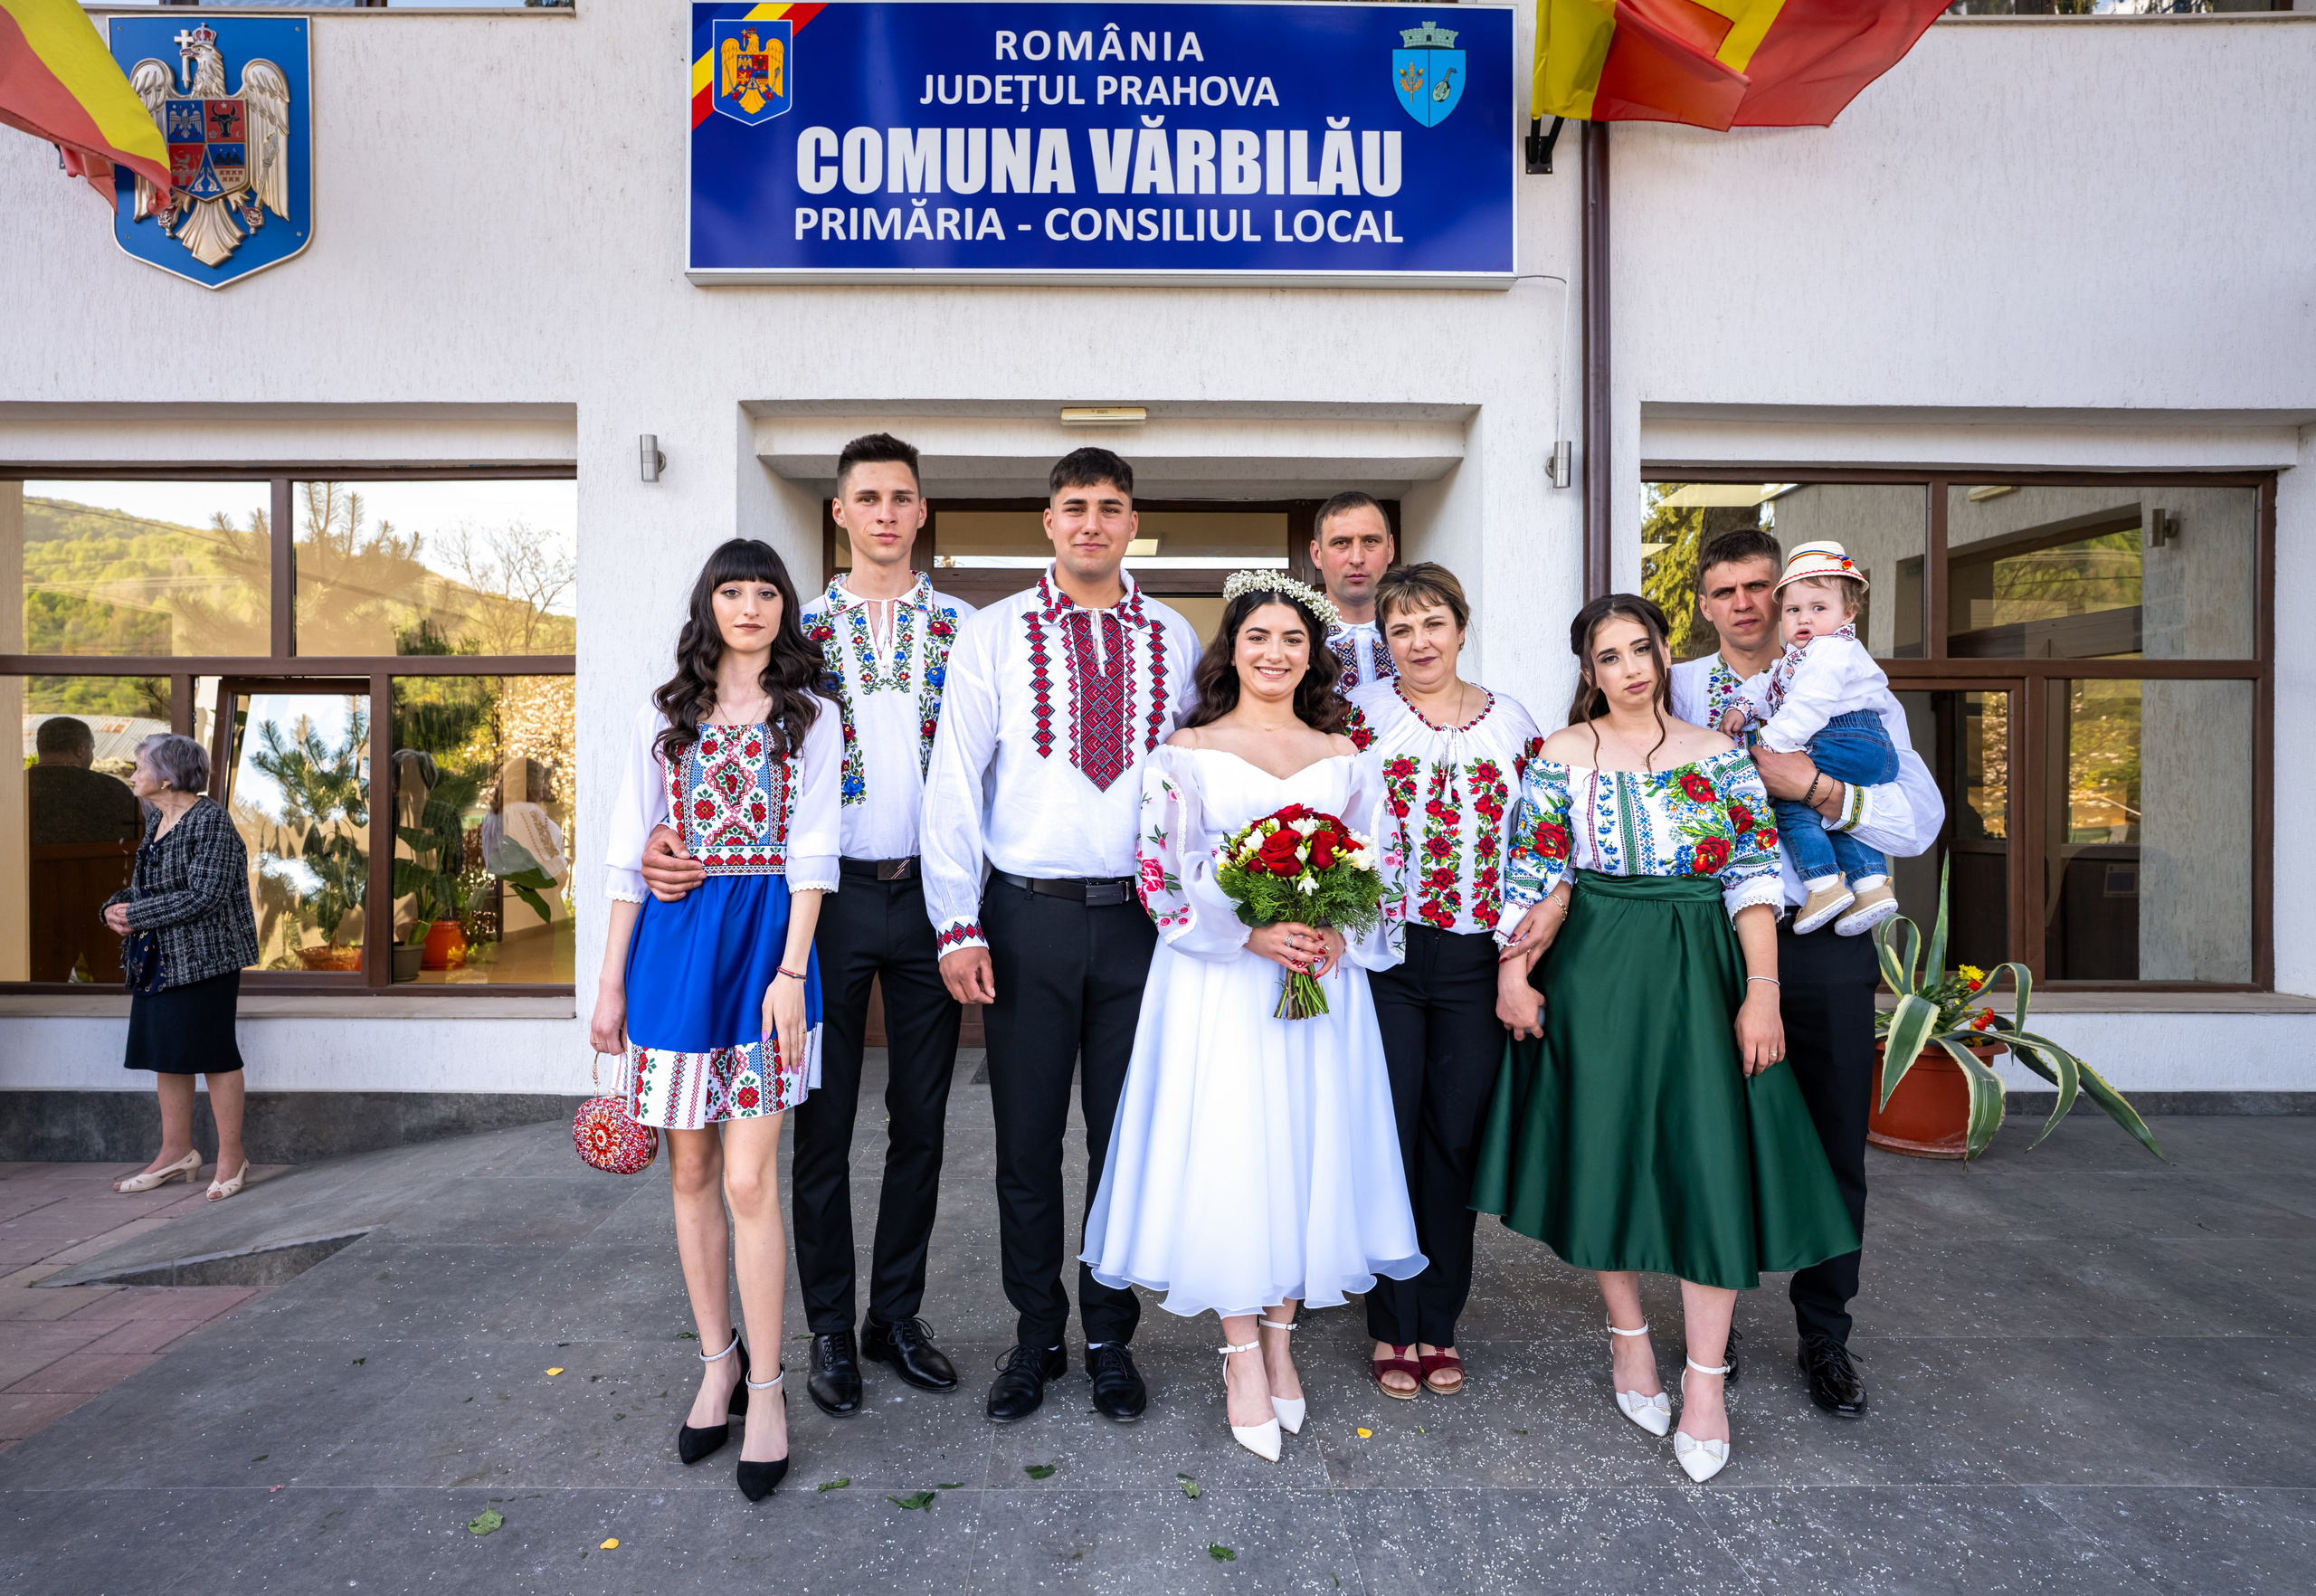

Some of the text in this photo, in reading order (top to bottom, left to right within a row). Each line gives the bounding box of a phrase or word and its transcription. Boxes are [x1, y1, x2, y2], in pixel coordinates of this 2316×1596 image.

[995, 23, 1204, 62] ROMÂNIA
[920, 74, 1280, 112] JUDEȚUL PRAHOVA
[796, 114, 1402, 197] COMUNA VĂRBILĂU
[795, 198, 1006, 241] PRIMĂRIA
[1045, 207, 1261, 242] CONSILIUL
[1275, 209, 1404, 243] LOCAL
